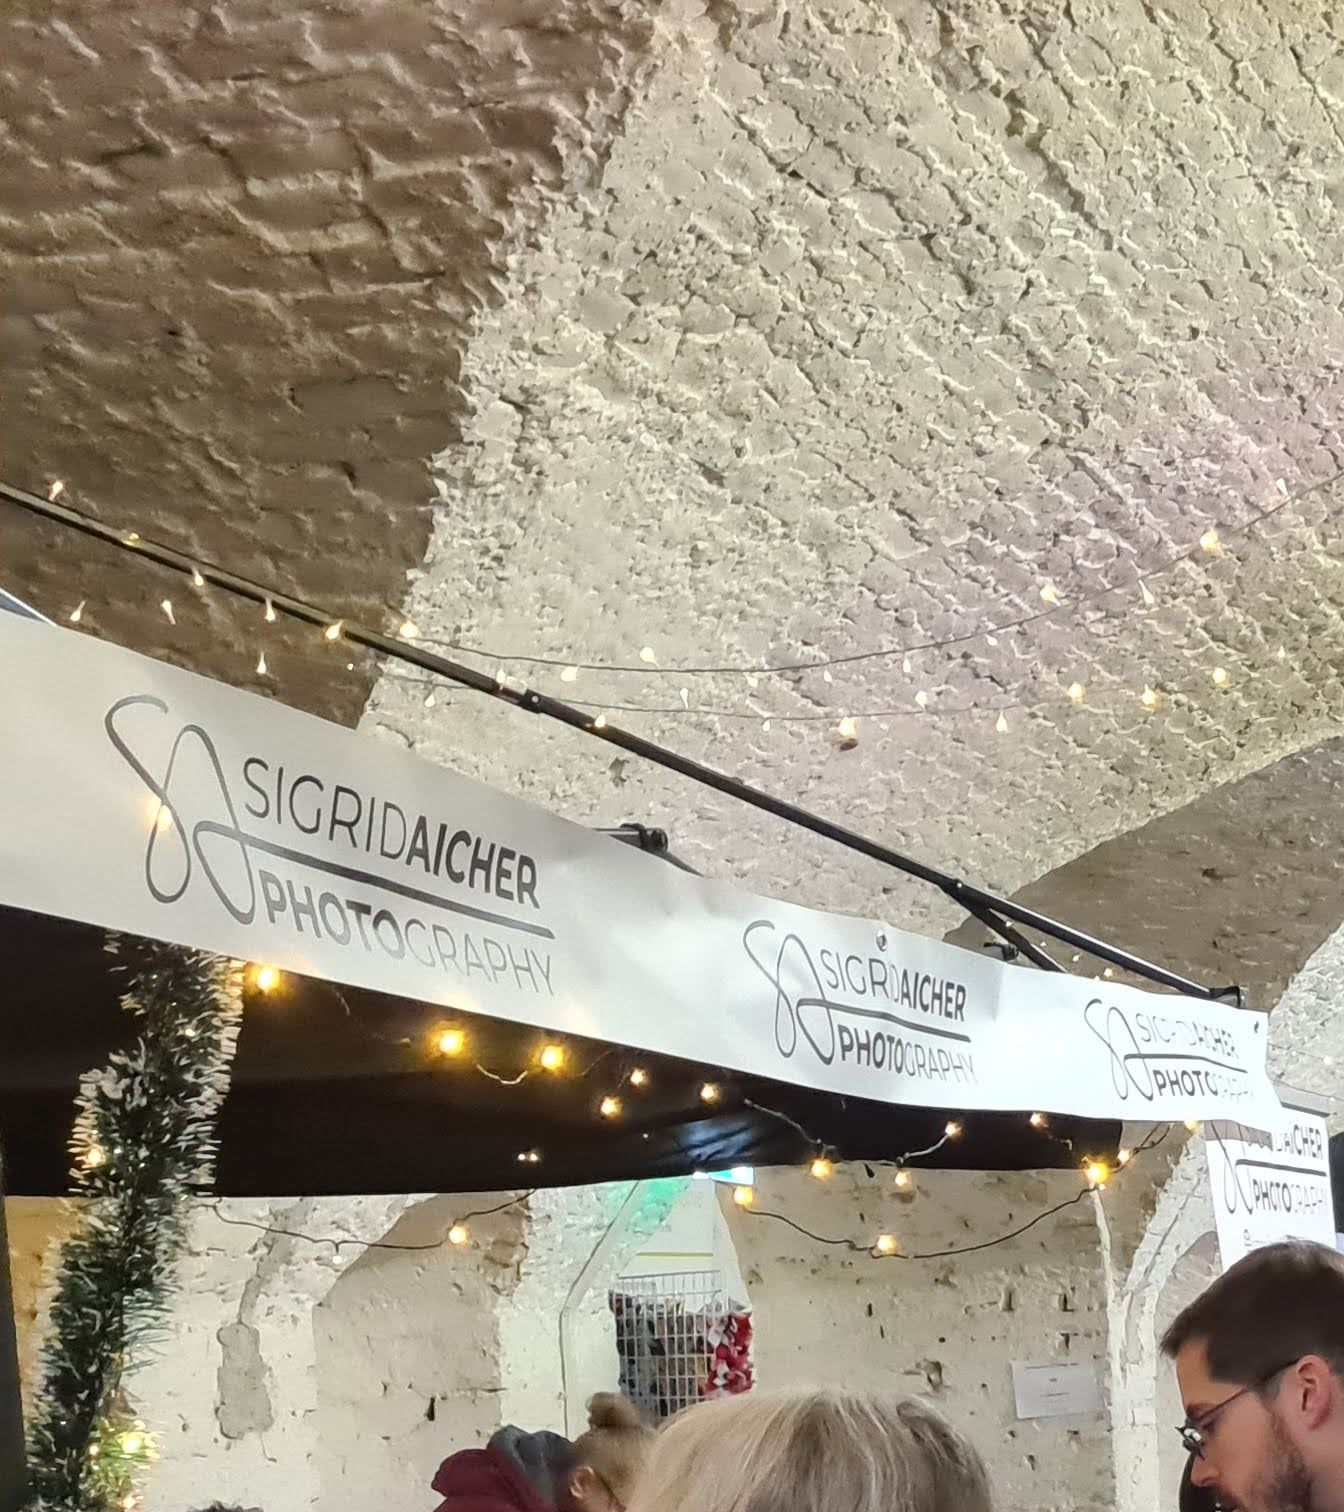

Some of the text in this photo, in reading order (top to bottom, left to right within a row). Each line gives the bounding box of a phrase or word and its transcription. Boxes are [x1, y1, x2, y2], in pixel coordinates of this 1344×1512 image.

[242, 756, 541, 909] SIGRIDAICHER
[258, 868, 554, 996] PHOTOGRAPHY
[838, 1024, 979, 1084] PHOTOGRAPHY
